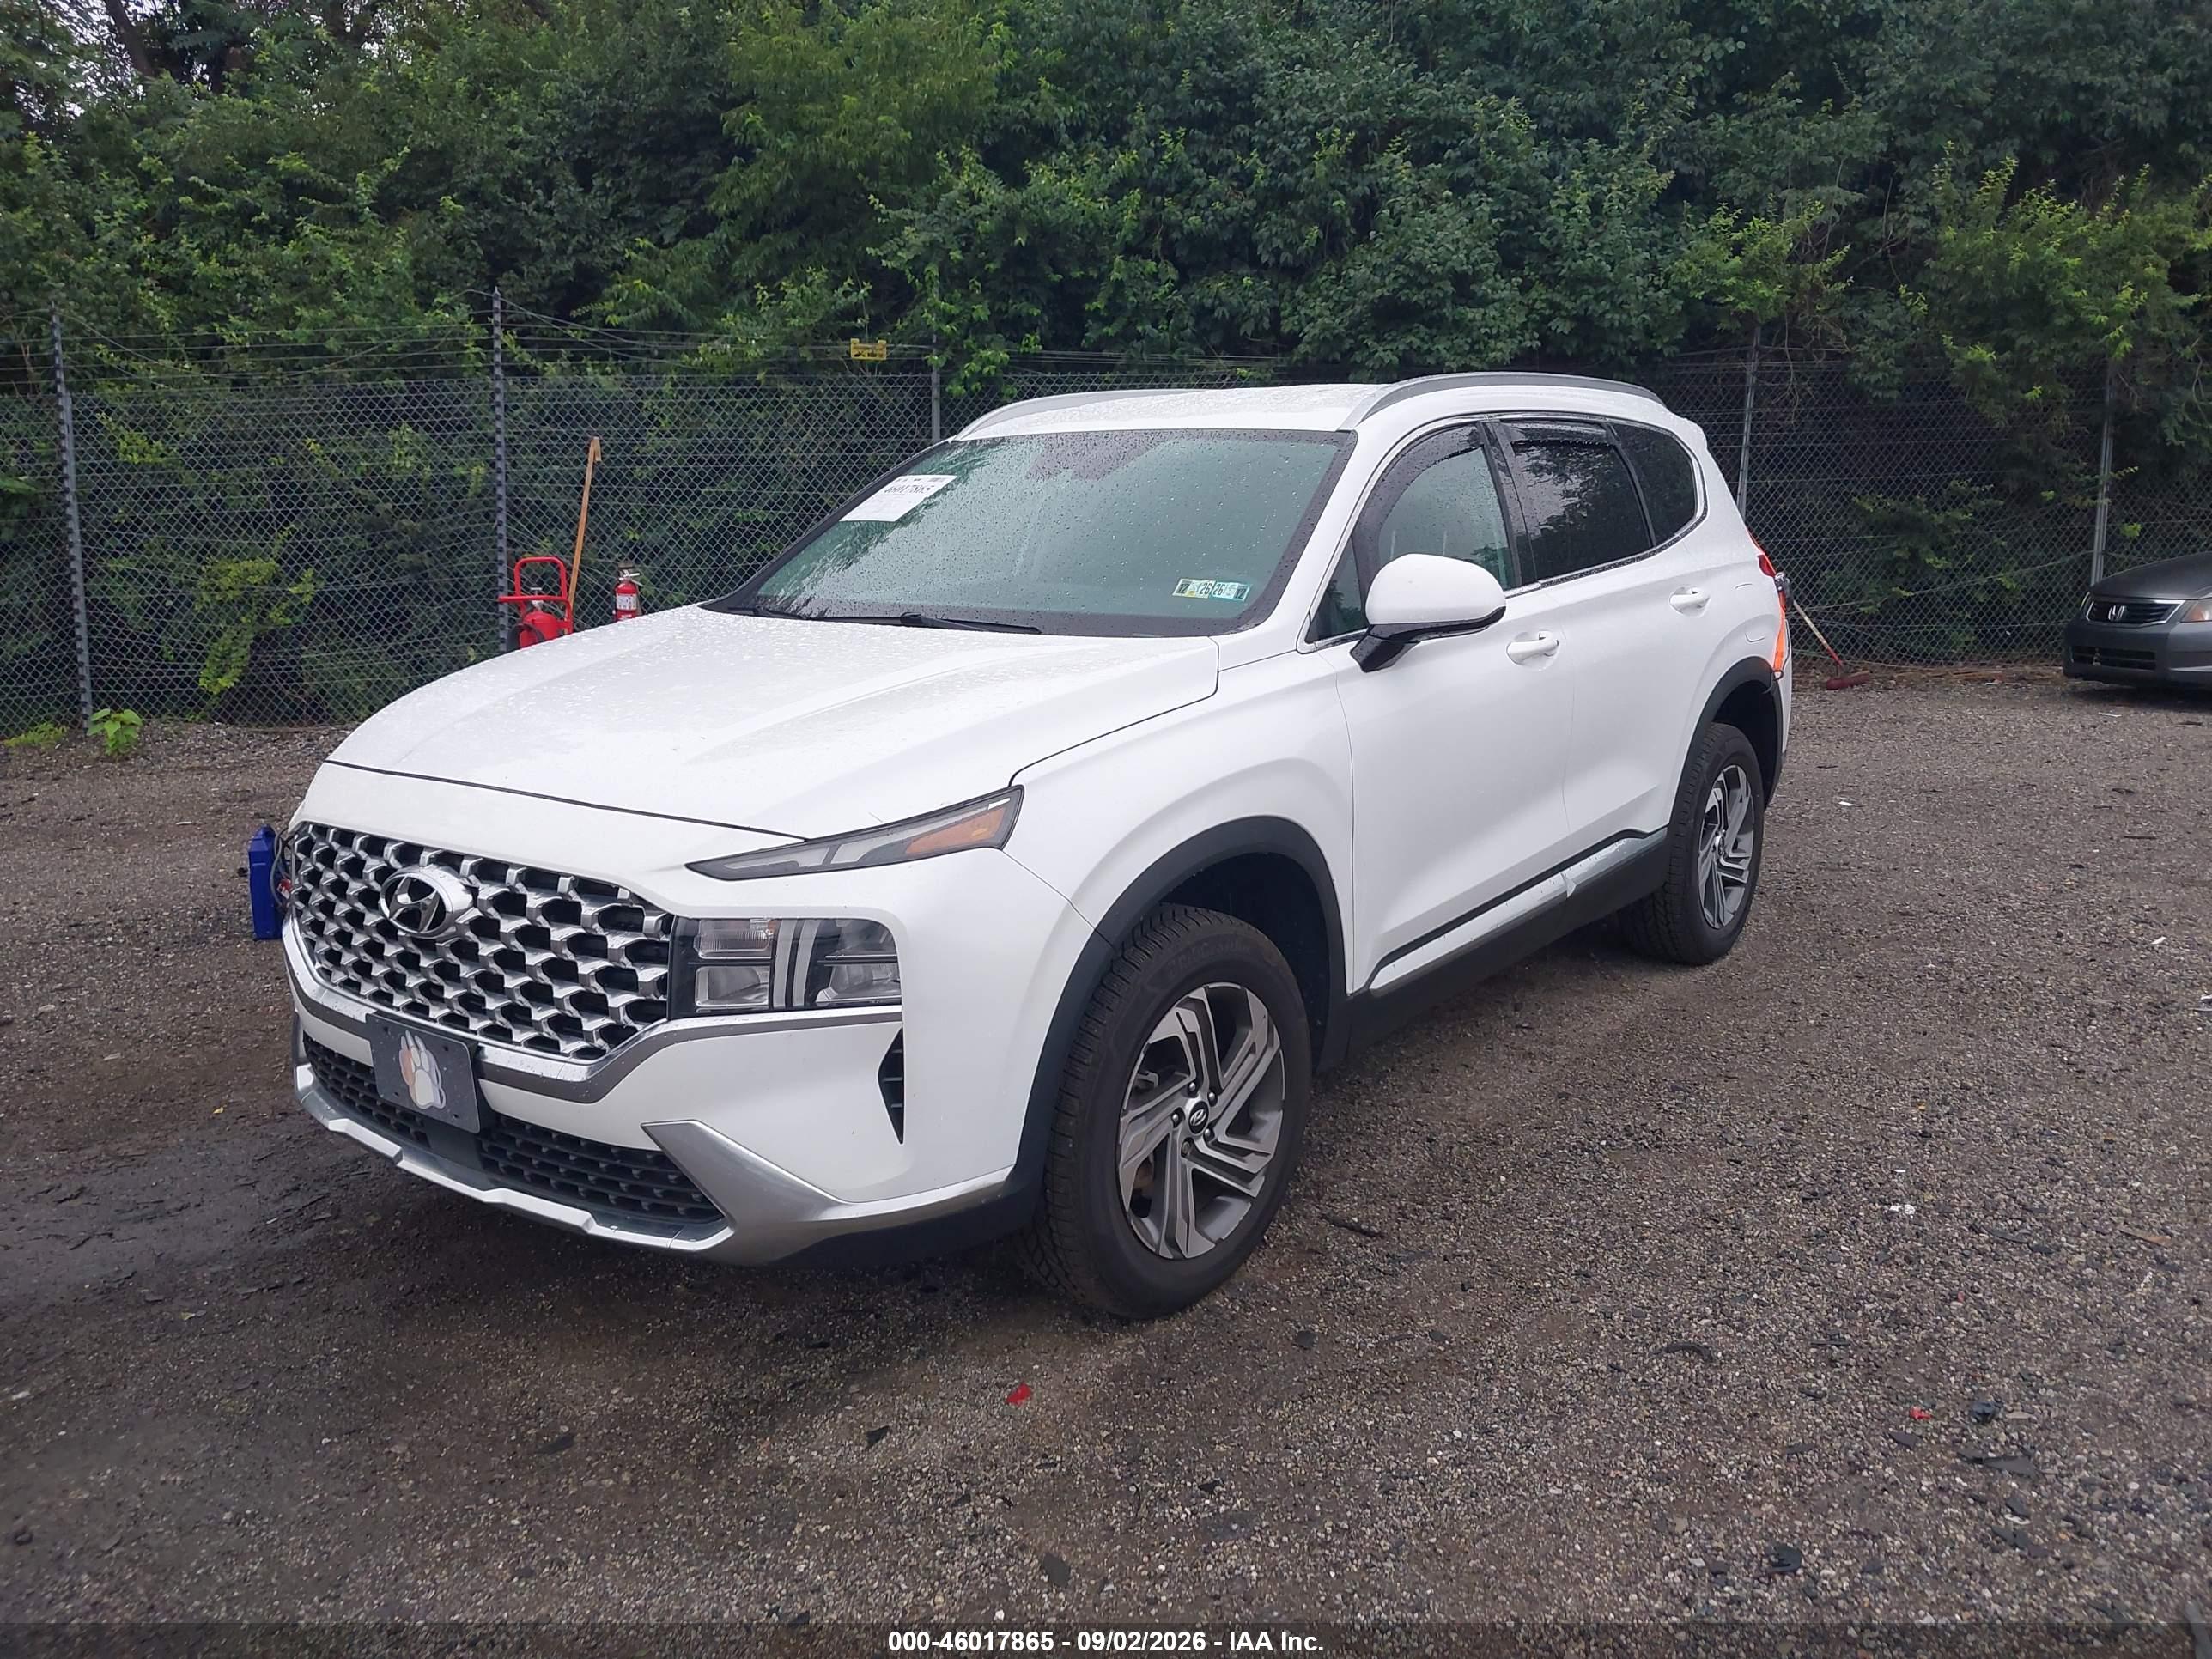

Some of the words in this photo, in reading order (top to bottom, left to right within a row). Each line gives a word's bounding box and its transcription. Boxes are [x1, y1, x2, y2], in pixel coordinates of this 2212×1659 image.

[1176, 583, 1189, 593] 12
[1200, 582, 1212, 595] 26
[1212, 583, 1225, 596] 26
[1235, 588, 1247, 599] 12
